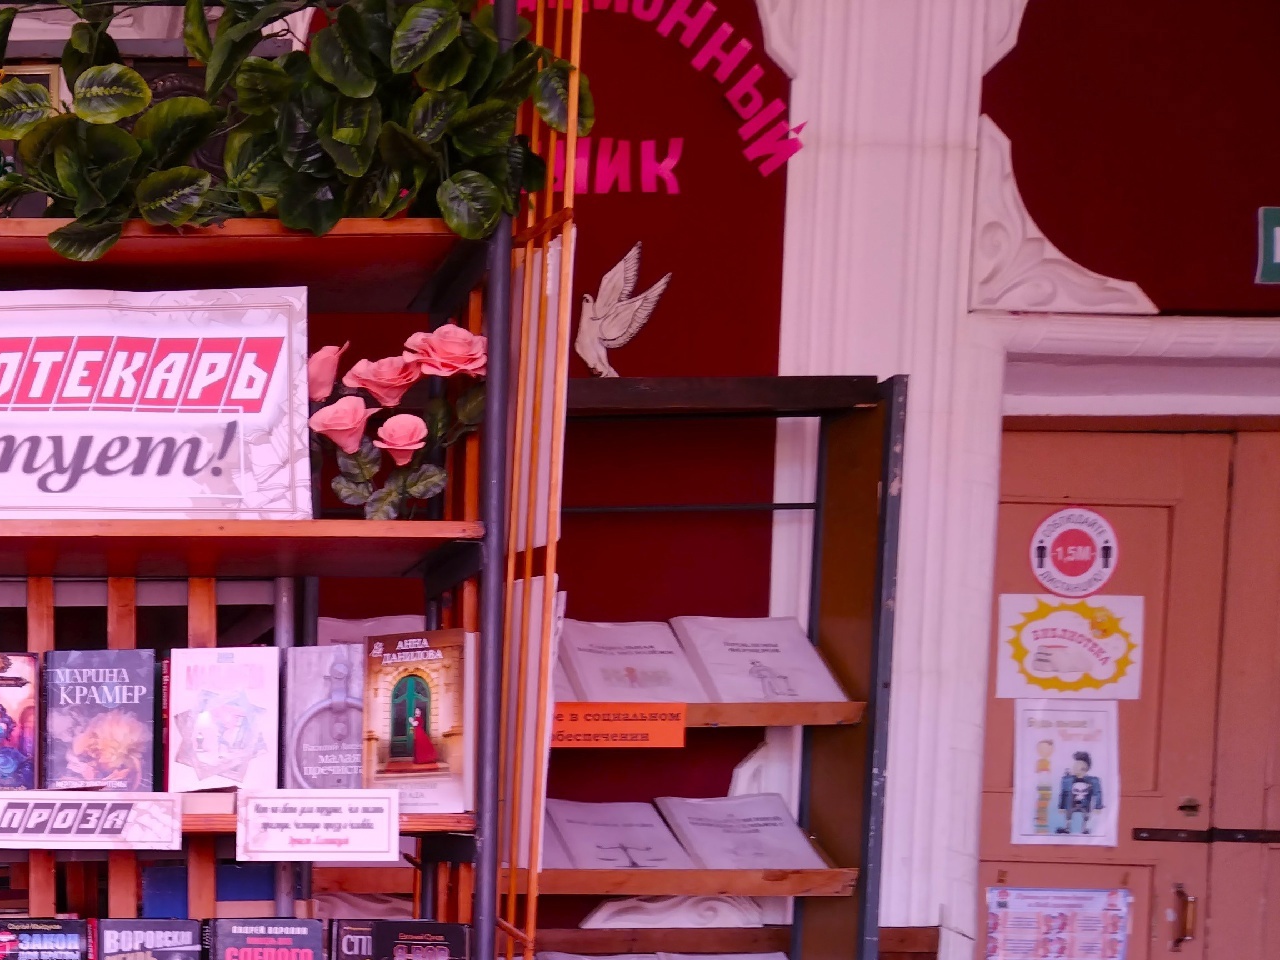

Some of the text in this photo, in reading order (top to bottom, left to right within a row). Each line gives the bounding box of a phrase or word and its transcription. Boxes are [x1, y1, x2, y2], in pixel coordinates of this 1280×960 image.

[394, 637, 430, 651] АННА
[381, 648, 444, 665] ДАНИЛОВА
[56, 668, 131, 684] МАРИНА
[59, 686, 148, 705] КРАМЕР
[568, 710, 682, 725] в социальном
